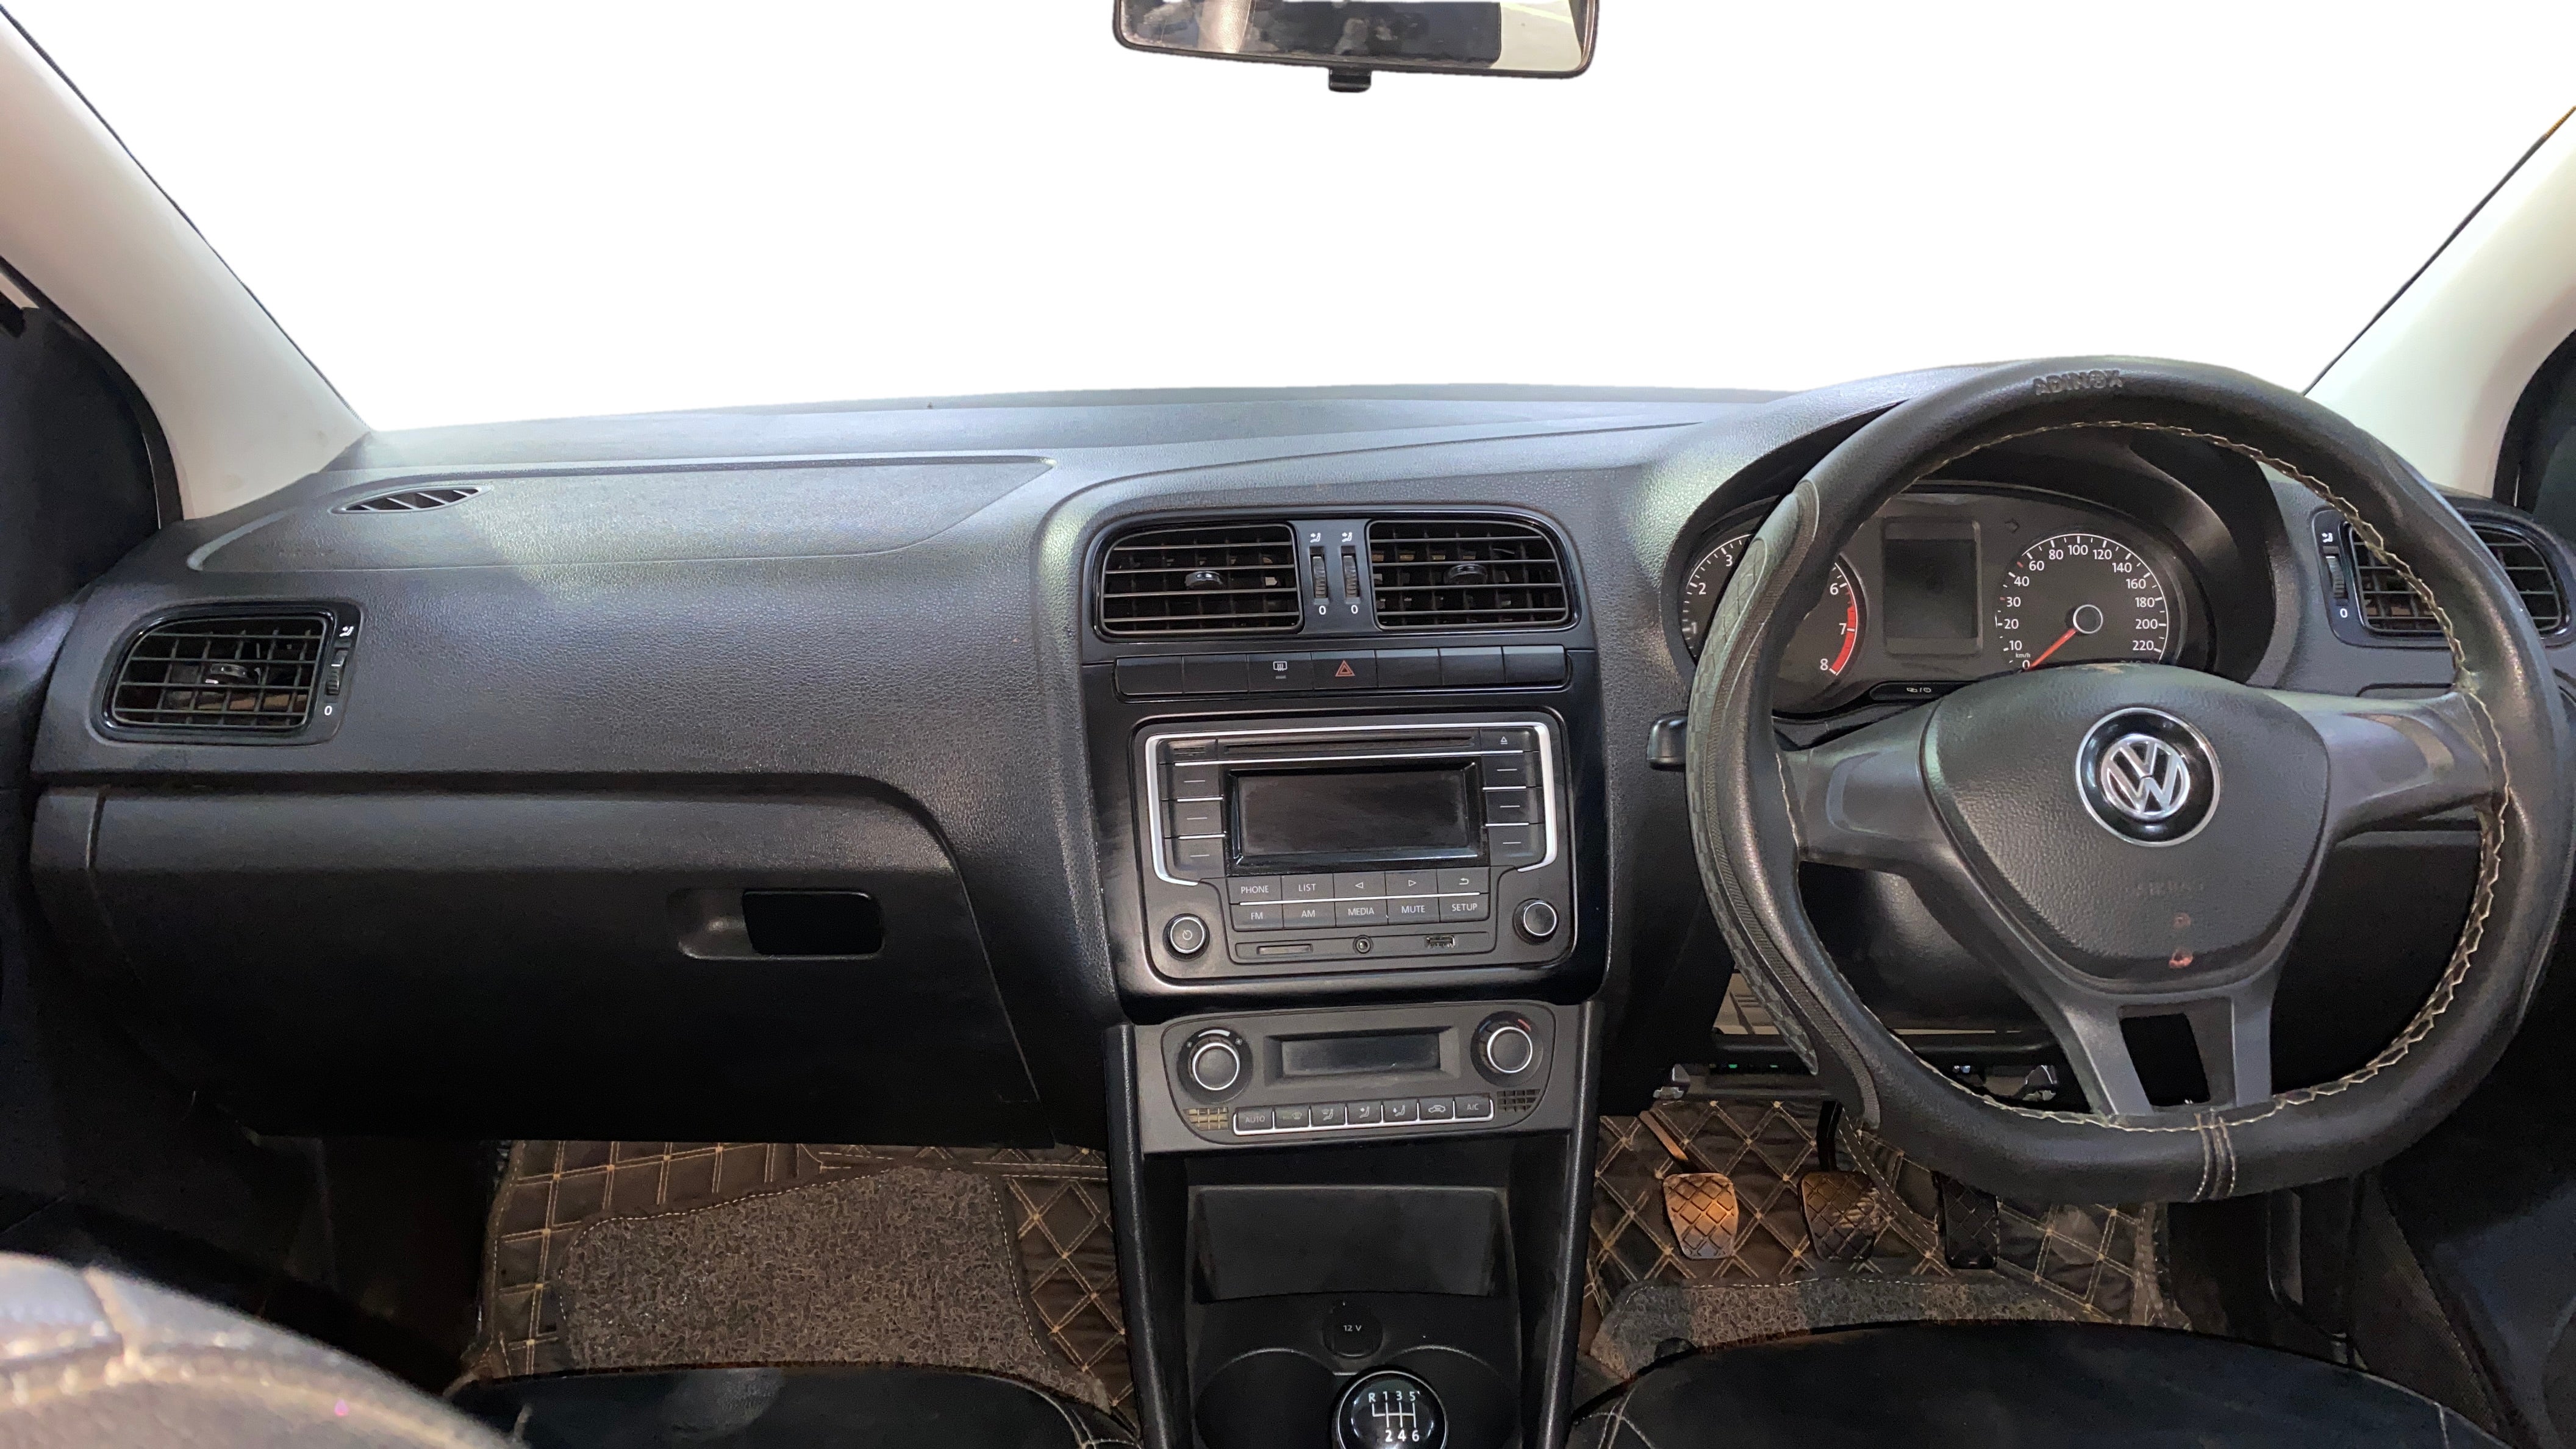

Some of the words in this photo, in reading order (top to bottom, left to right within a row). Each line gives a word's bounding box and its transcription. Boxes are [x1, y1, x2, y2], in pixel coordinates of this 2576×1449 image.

[2048, 549, 2064, 560] 80
[2067, 545, 2089, 556] 100
[2092, 549, 2112, 560] 120
[1725, 555, 1733, 567] 3
[2029, 560, 2045, 571] 60
[2112, 562, 2132, 573] 140
[2014, 576, 2030, 587] 40
[2126, 578, 2147, 589] 160
[1698, 582, 1706, 595] 2
[1830, 582, 1839, 595] 6
[2006, 596, 2021, 607] 30
[2134, 597, 2155, 607] 180
[1318, 606, 1326, 615] 0
[1351, 604, 1358, 614] 0
[2340, 608, 2347, 618] 0
[1691, 622, 1698, 634] 1
[1839, 623, 1847, 635] 7
[2004, 619, 2019, 629] 20
[2135, 619, 2158, 629] 200
[2009, 640, 2022, 651] 10
[2132, 640, 2155, 651] 220
[1819, 658, 1829, 671] 8
[2022, 660, 2031, 670] 0
[324, 705, 332, 716] 0
[1240, 885, 1269, 894] PHONE
[1298, 883, 1317, 892] LIST
[1348, 907, 1375, 916] MEDIA
[1401, 905, 1425, 914] MUTE
[1451, 903, 1478, 912] SETUP
[1301, 909, 1315, 918] AM
[1245, 1115, 1265, 1123] AUTO
[1368, 1393, 1376, 1402] R
[1383, 1390, 1388, 1400] 1
[1396, 1390, 1402, 1401] 3
[1409, 1391, 1416, 1401] 5
[1385, 1430, 1392, 1442] 2
[1398, 1429, 1406, 1441] 4
[1412, 1429, 1420, 1442] 6
